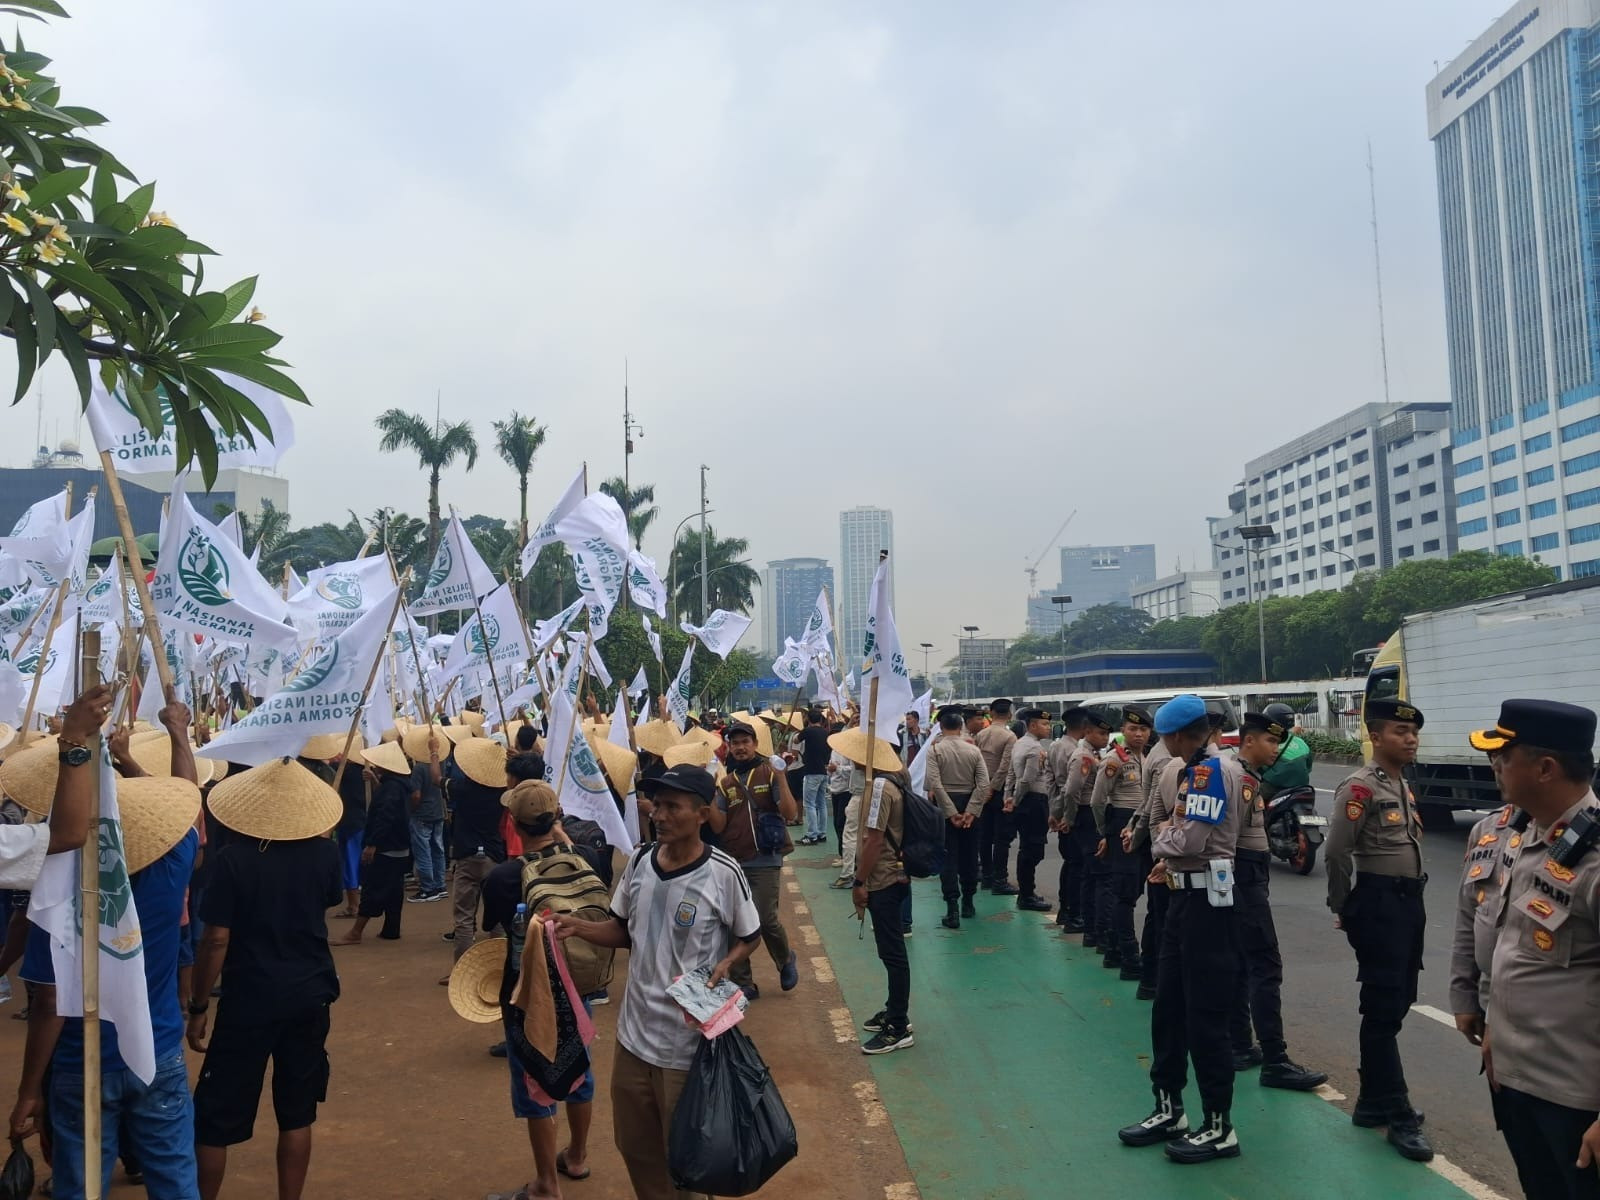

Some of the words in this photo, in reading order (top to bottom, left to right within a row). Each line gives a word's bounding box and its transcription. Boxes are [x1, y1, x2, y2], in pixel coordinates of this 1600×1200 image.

[182, 600, 255, 631] NASIONAL
[188, 616, 252, 638] AGRARIA
[1534, 875, 1571, 906] POLRI
